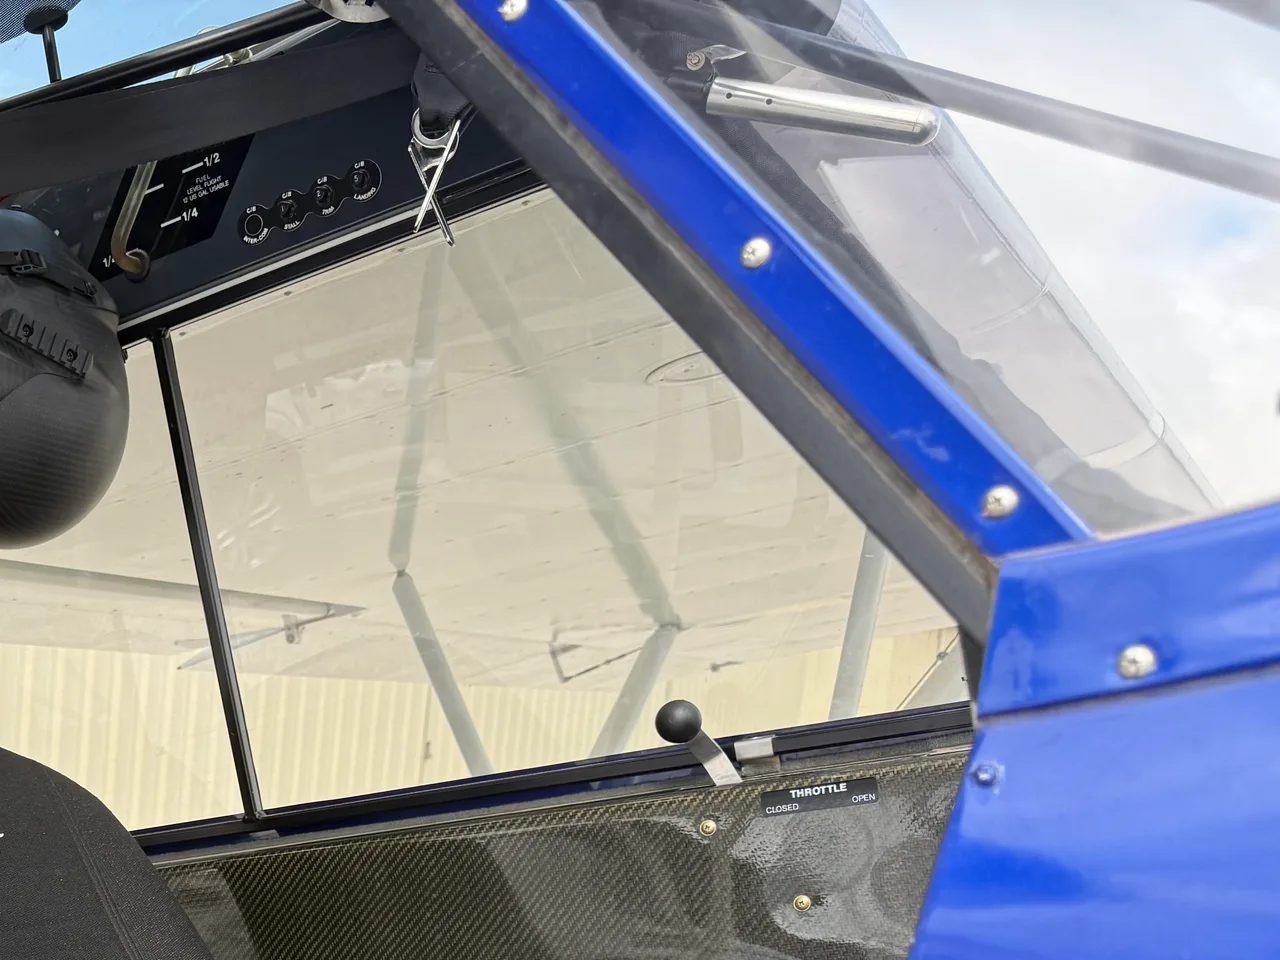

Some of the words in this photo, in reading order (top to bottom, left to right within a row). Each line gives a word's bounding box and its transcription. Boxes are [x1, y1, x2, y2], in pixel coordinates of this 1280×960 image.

[204, 153, 221, 167] 1/2
[354, 161, 365, 169] C/B
[195, 174, 211, 184] FUEL
[317, 176, 328, 184] C/B
[187, 184, 203, 195] LEVEL
[204, 175, 222, 187] FLIGHT
[189, 193, 198, 201] US
[198, 189, 209, 198] GAL
[209, 180, 230, 193] USABLE
[282, 191, 292, 199] C/B
[353, 187, 377, 200] LANDING
[182, 207, 199, 221] 1/4
[246, 206, 257, 214] C/B
[322, 206, 335, 215] TRIM
[283, 220, 300, 230] STALL
[789, 783, 848, 799] THROTTLE
[851, 793, 876, 804] OPEN
[765, 803, 800, 814] CLOSED
